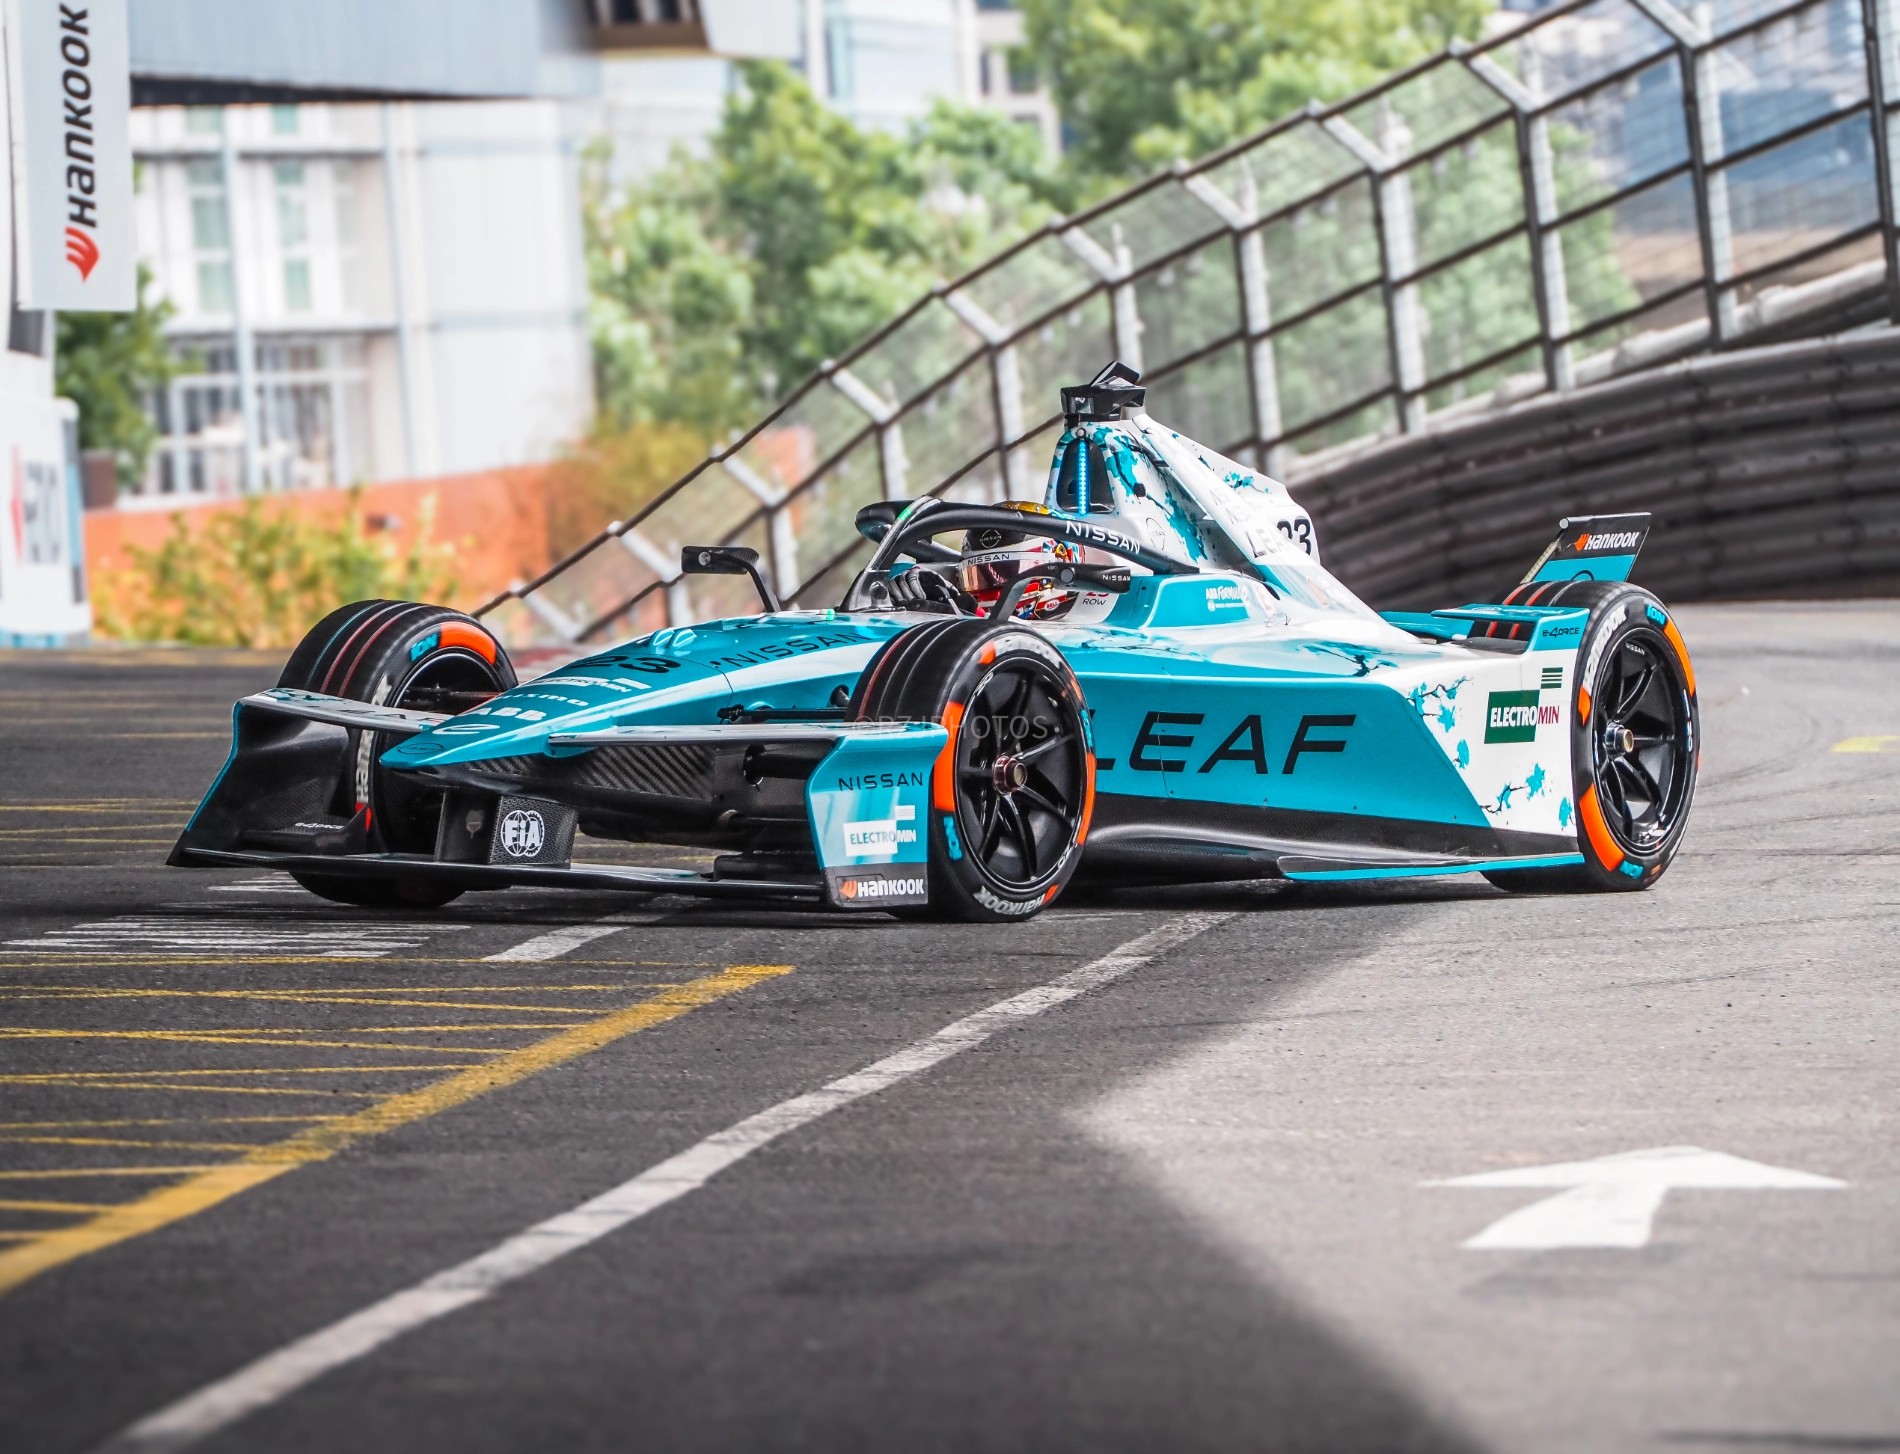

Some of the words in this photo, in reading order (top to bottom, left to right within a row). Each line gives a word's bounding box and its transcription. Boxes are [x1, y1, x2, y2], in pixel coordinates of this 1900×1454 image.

[1065, 520, 1141, 555] NISSAN
[967, 553, 1010, 566] NISSAN
[1102, 573, 1131, 583] NISSAN
[1046, 602, 1058, 611] BELL
[719, 632, 873, 668] NISSAN
[564, 655, 682, 674] 23
[1490, 705, 1560, 728] ELECTROMIN
[838, 772, 923, 791] NISSAN
[850, 829, 917, 845] ELECTROMIN
